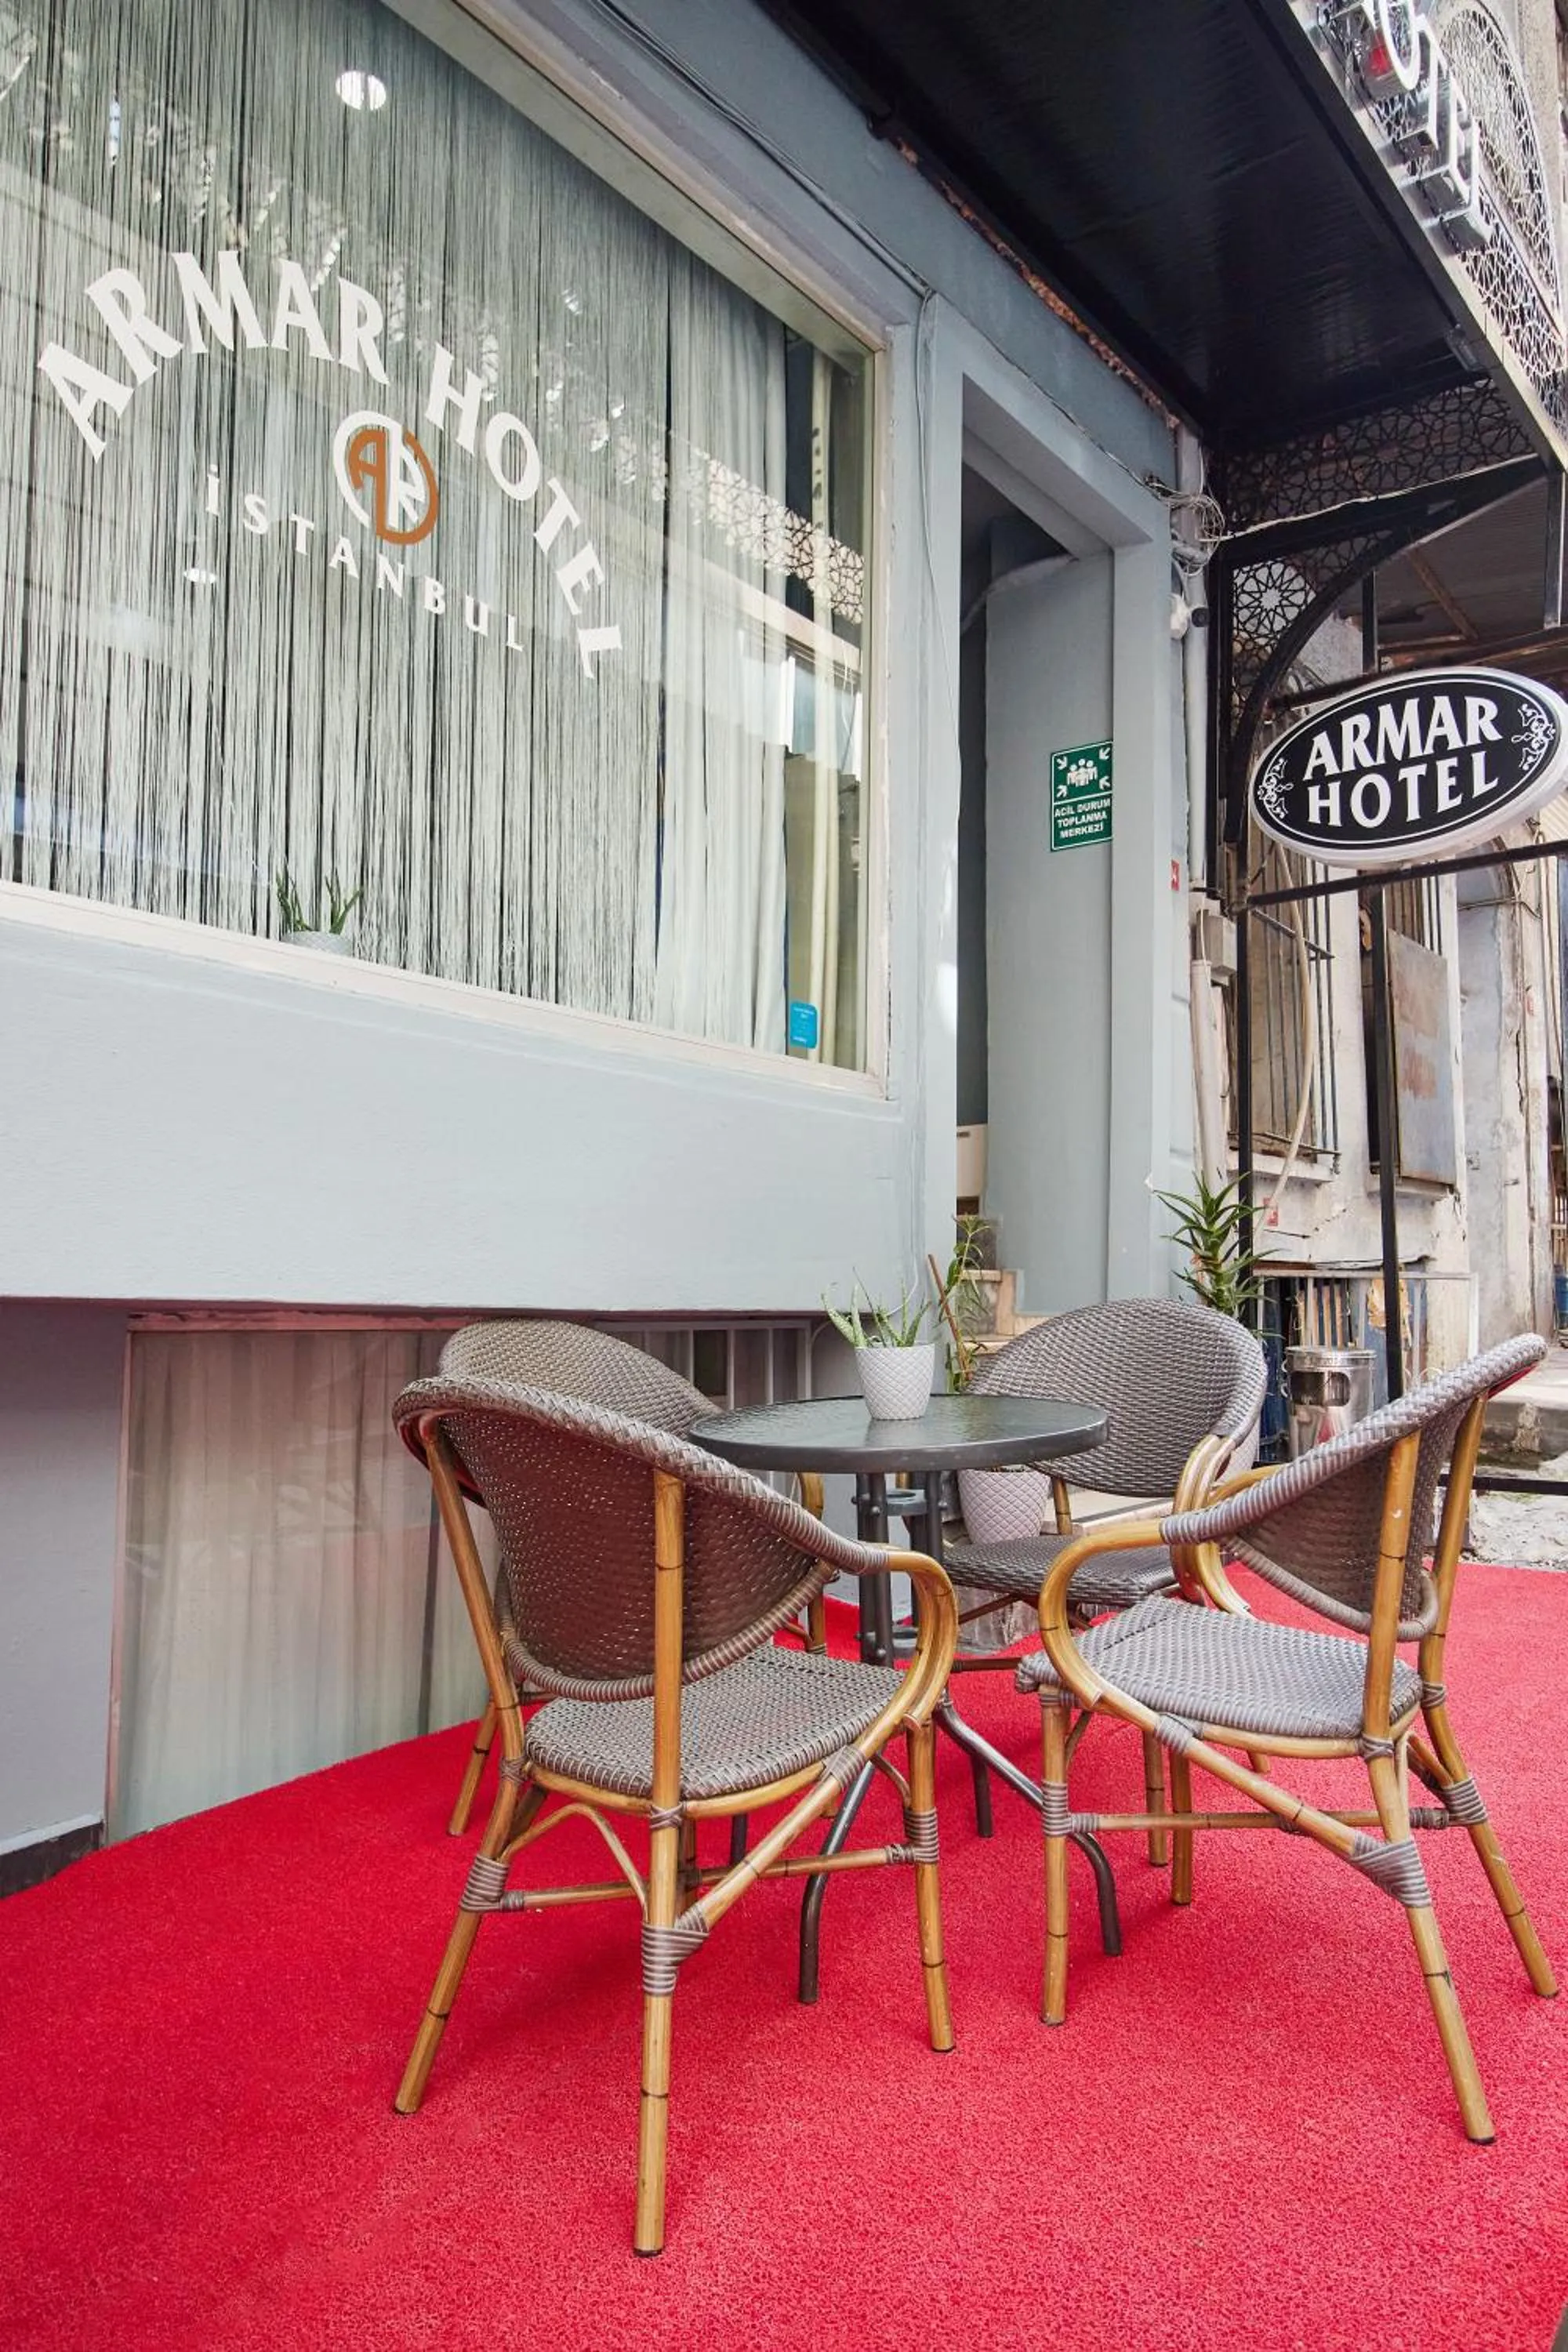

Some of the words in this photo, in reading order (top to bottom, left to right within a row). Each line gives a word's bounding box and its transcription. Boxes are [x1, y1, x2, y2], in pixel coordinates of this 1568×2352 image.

[1359, 0, 1493, 240] OTEL
[38, 251, 389, 463] ARMAR
[425, 343, 622, 679] HOTEL
[1302, 695, 1503, 781] ARMAR
[1057, 811, 1107, 829] TOPLANMA
[1077, 798, 1111, 813] DURUM
[1307, 750, 1499, 828] HOTEL
[1060, 821, 1104, 838] MERKEZİ
